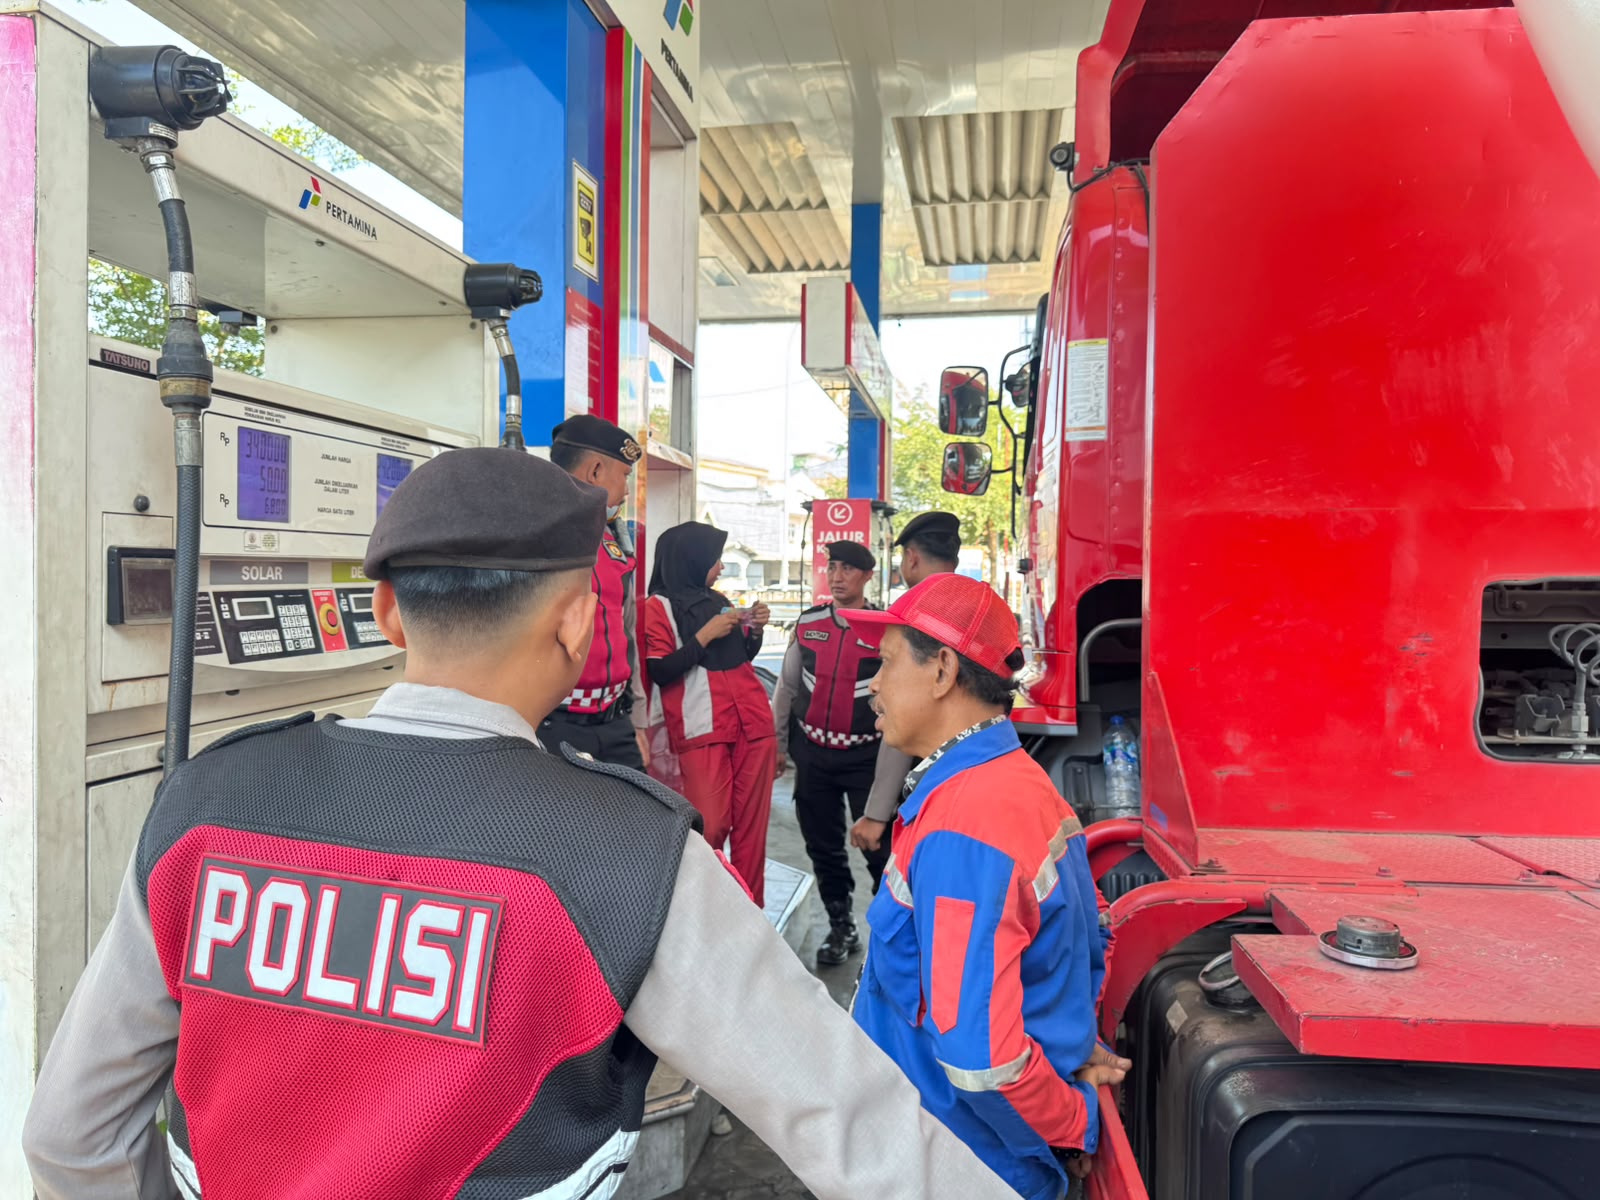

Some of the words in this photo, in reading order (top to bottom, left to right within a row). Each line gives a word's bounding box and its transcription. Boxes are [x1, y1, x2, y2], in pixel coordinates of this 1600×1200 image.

[326, 201, 378, 241] PERTAMINA
[220, 431, 230, 447] Rp
[220, 493, 230, 508] Rp
[816, 531, 865, 543] JALUR
[241, 565, 283, 581] SOLAR
[191, 865, 492, 1034] POLISI
